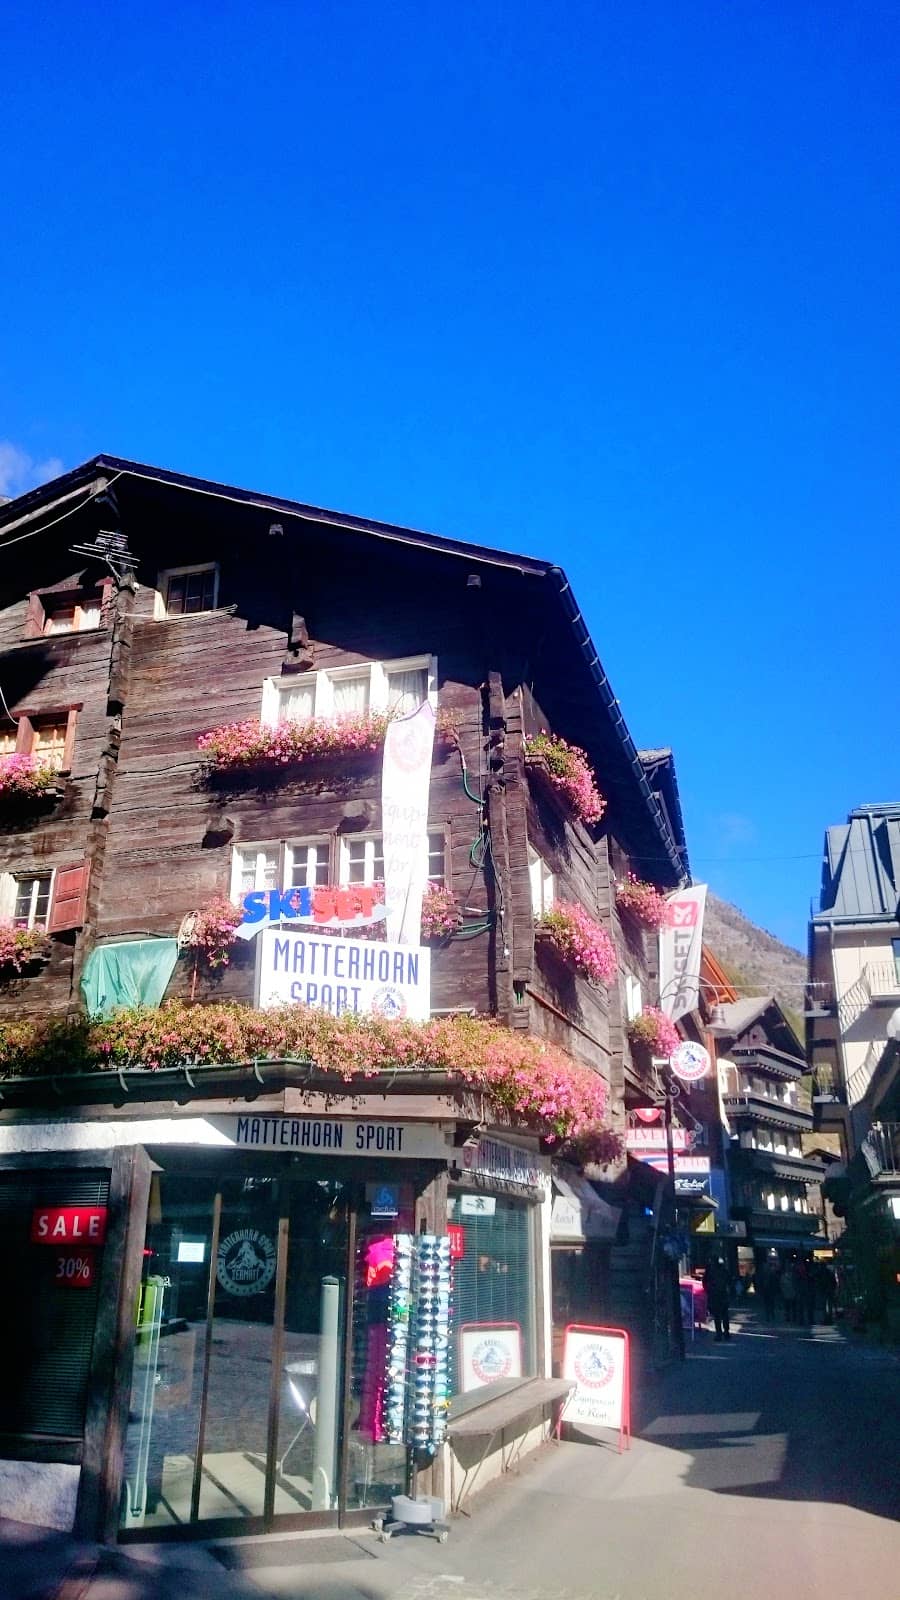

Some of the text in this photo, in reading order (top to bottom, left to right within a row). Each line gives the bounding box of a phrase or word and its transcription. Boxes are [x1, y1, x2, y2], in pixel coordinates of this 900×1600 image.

[242, 886, 378, 924] SKISET
[273, 938, 419, 985] MATTERHORN
[290, 981, 361, 1017] SPORT
[237, 1118, 404, 1151] MATTERHORN SPORT
[38, 1215, 100, 1237] SALE
[56, 1257, 90, 1279] 30%
